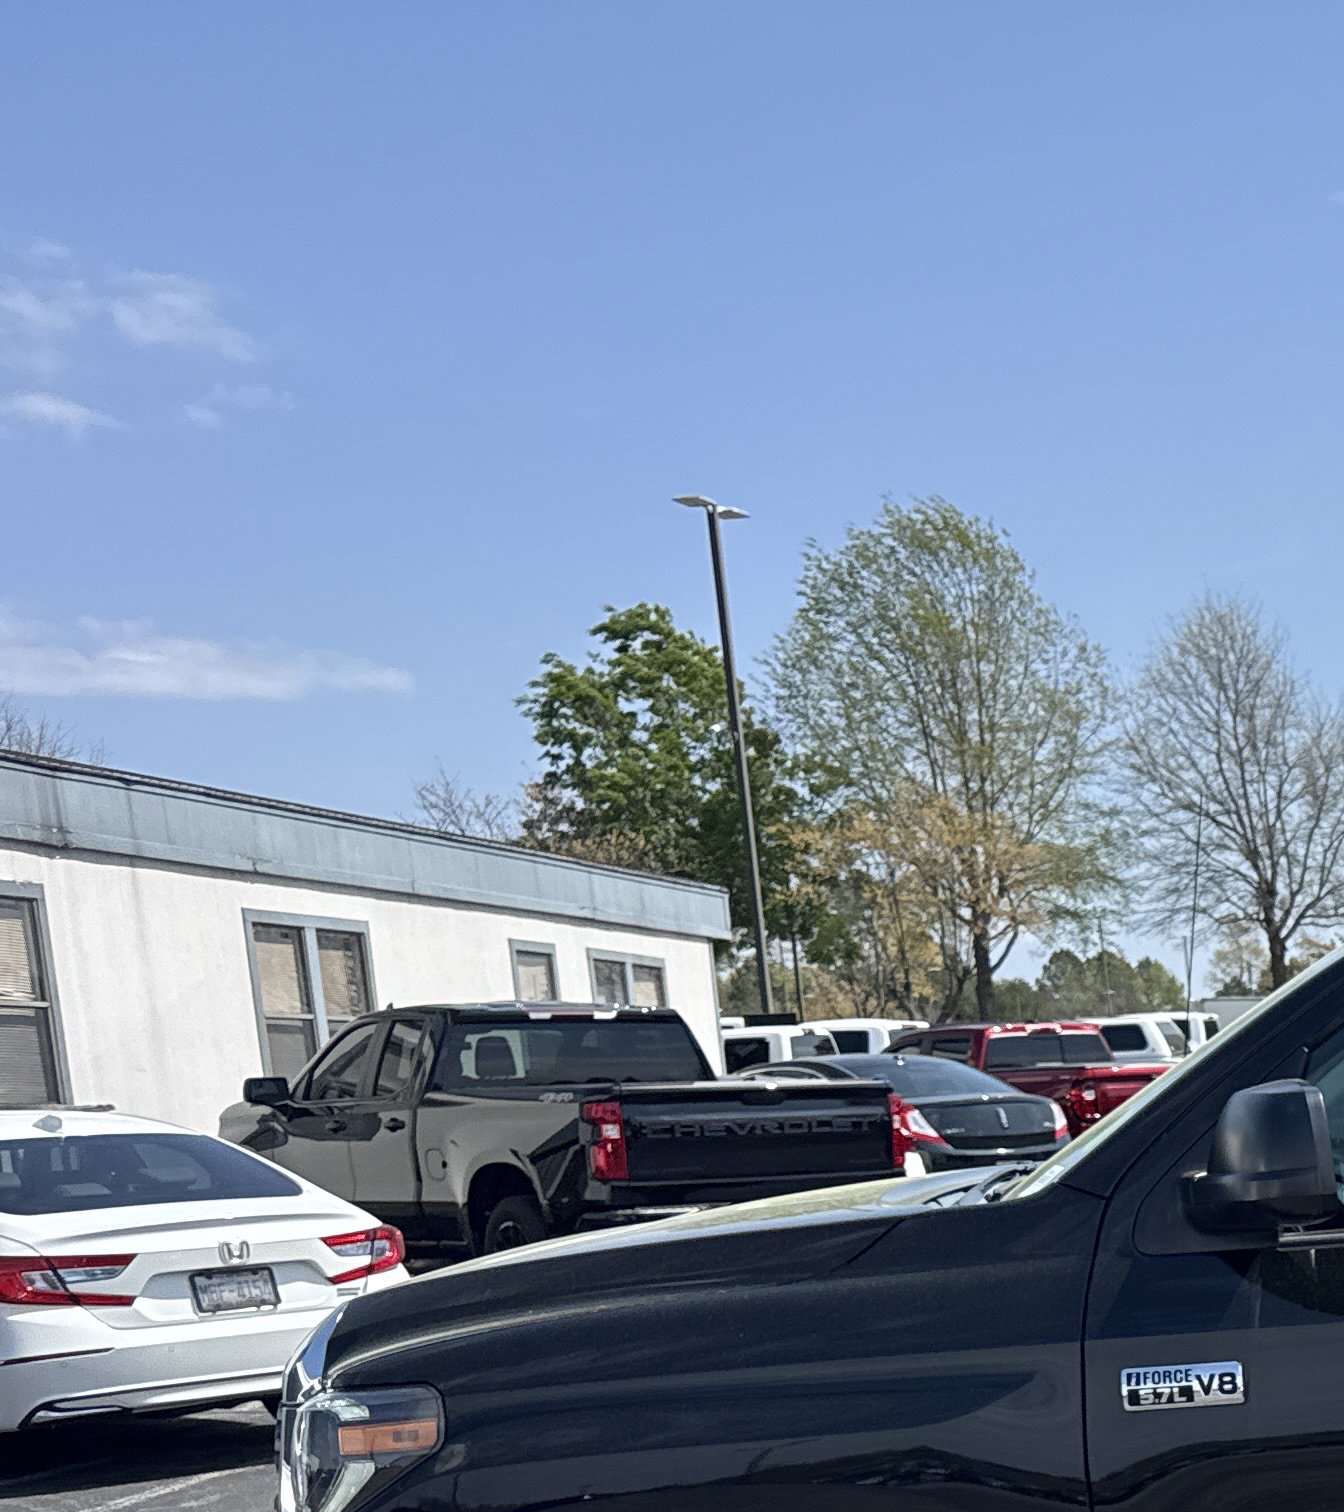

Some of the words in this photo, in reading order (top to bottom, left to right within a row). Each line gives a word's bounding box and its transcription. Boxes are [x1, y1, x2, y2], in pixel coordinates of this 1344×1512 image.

[644, 1116, 876, 1139] CHEVROLET
[1138, 1386, 1188, 1404] 5.7L
[1195, 1372, 1238, 1396] V8
